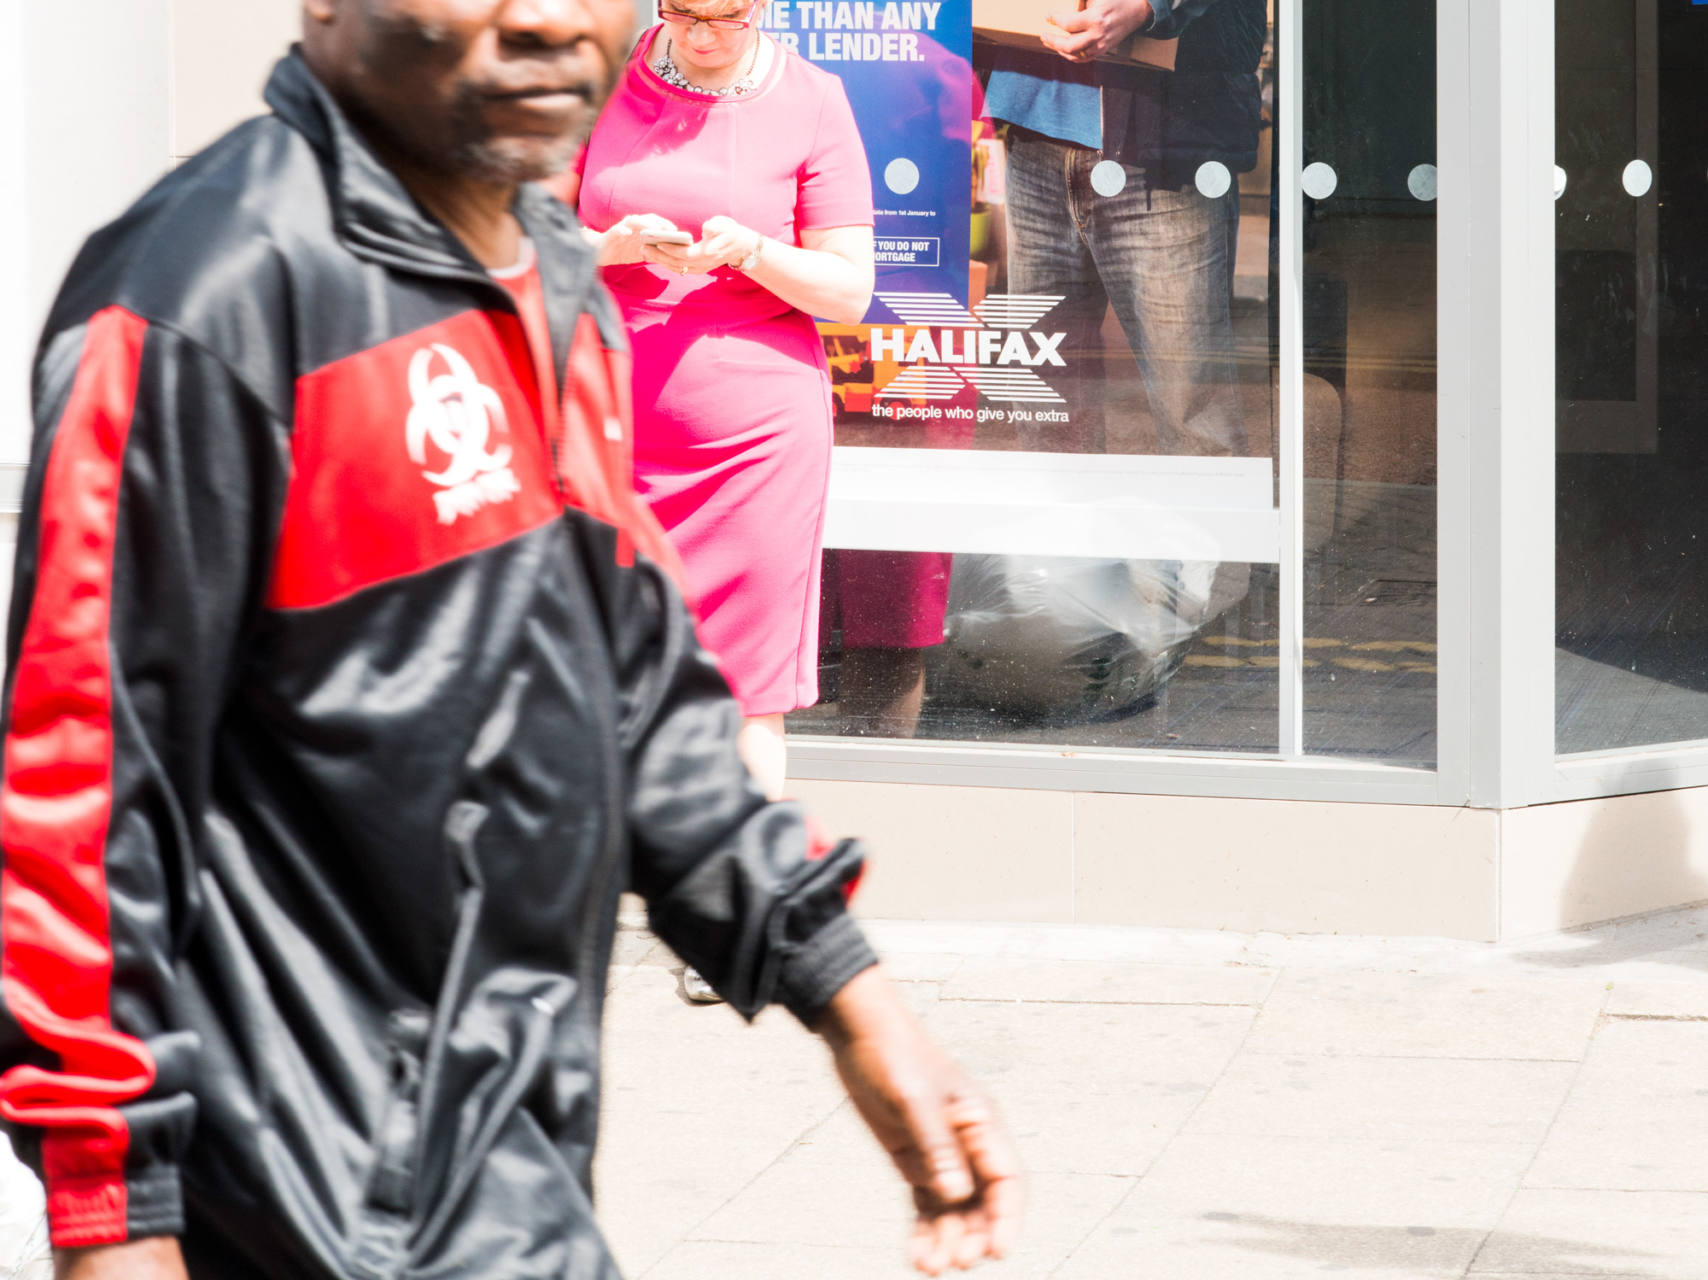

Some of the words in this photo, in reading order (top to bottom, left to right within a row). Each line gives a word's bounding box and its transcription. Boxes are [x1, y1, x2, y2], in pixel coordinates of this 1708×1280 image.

[796, 1, 875, 30] THAN
[880, 1, 942, 30] ANY
[808, 32, 925, 61] LENDER.
[875, 252, 916, 262] ORTGAGE
[878, 241, 896, 251] YOU
[896, 241, 910, 251] DO
[911, 241, 930, 251] NOT
[870, 327, 1068, 368] HALIFAX
[871, 403, 894, 418] the
[896, 405, 942, 421] people
[945, 405, 974, 420] who
[976, 407, 1005, 423] give
[1007, 409, 1033, 424] you
[1035, 409, 1070, 423] extra
